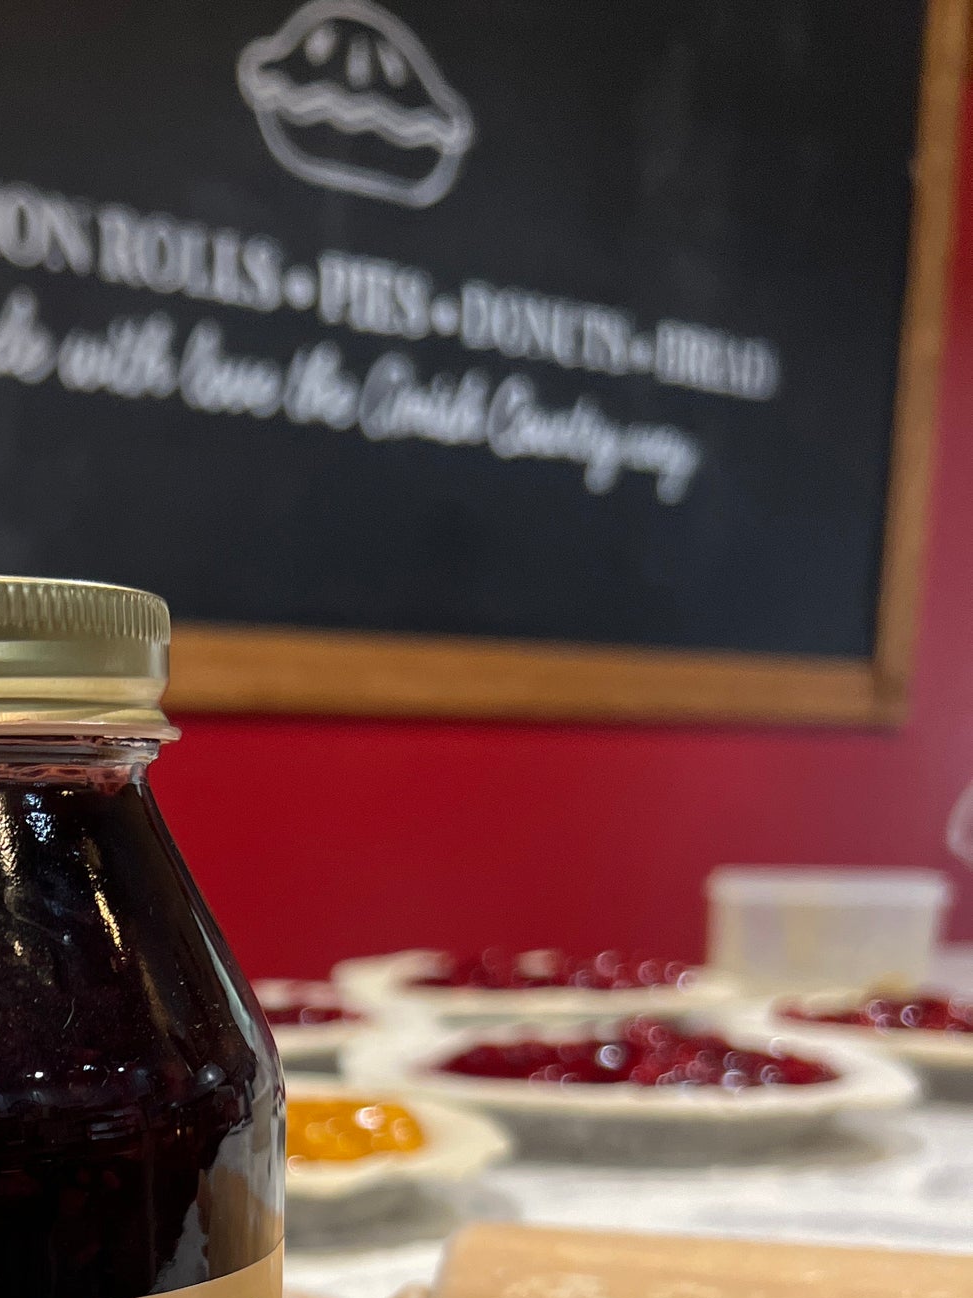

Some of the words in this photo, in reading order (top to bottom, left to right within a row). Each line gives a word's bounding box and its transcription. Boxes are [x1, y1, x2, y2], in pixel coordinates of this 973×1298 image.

[99, 204, 282, 311] ROLLS
[319, 250, 430, 339] PIES
[461, 279, 630, 375] DONUTS
[57, 311, 178, 398] with
